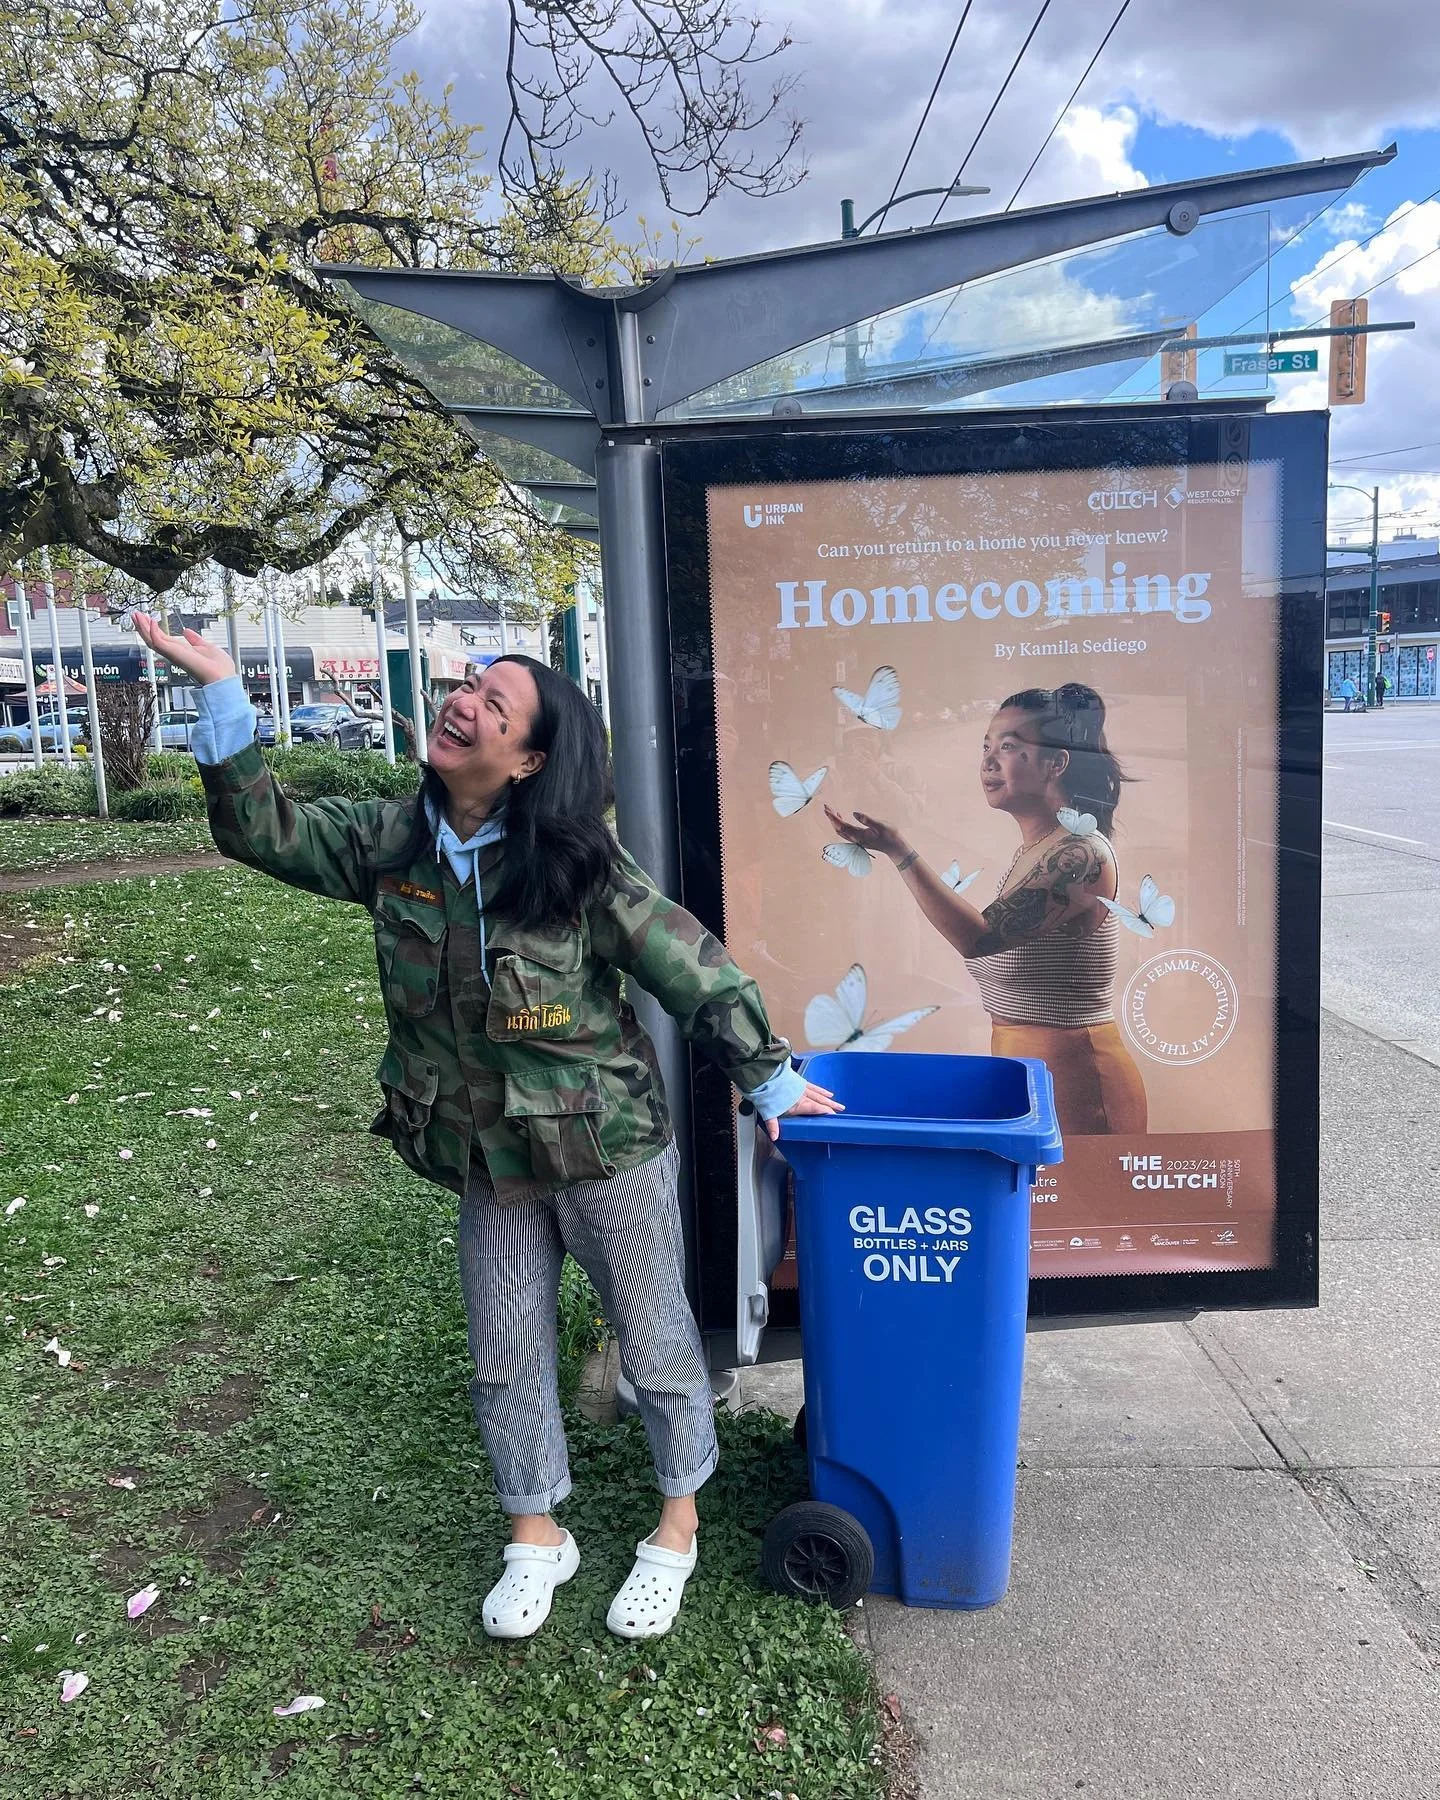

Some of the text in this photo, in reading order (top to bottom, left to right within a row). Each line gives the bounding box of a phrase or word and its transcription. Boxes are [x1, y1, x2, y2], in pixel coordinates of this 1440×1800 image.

[1231, 354, 1310, 372] Fraser St
[1186, 489, 1240, 498] WEST COAST
[765, 503, 803, 514] URBAN
[765, 515, 785, 526] INK
[817, 528, 1168, 560] Can you return to a home you never knew?
[775, 561, 1212, 629] Homecoming
[993, 637, 1147, 661] By Kamila Sediego
[71, 667, 78, 679] y
[81, 663, 119, 676] Lmón
[248, 667, 255, 678] y
[1132, 959, 1229, 1056] FEMME FESTIVAL AT THE CULTCH
[1119, 1155, 1217, 1172] THE 2023/24
[1131, 1173, 1218, 1190] CULTCH
[1226, 1160, 1234, 1209] ANNIVERSARY
[849, 1205, 972, 1235] GLASS
[853, 1238, 917, 1250] BOTTLES
[932, 1240, 969, 1251] JARS
[863, 1254, 961, 1283] ONLY
